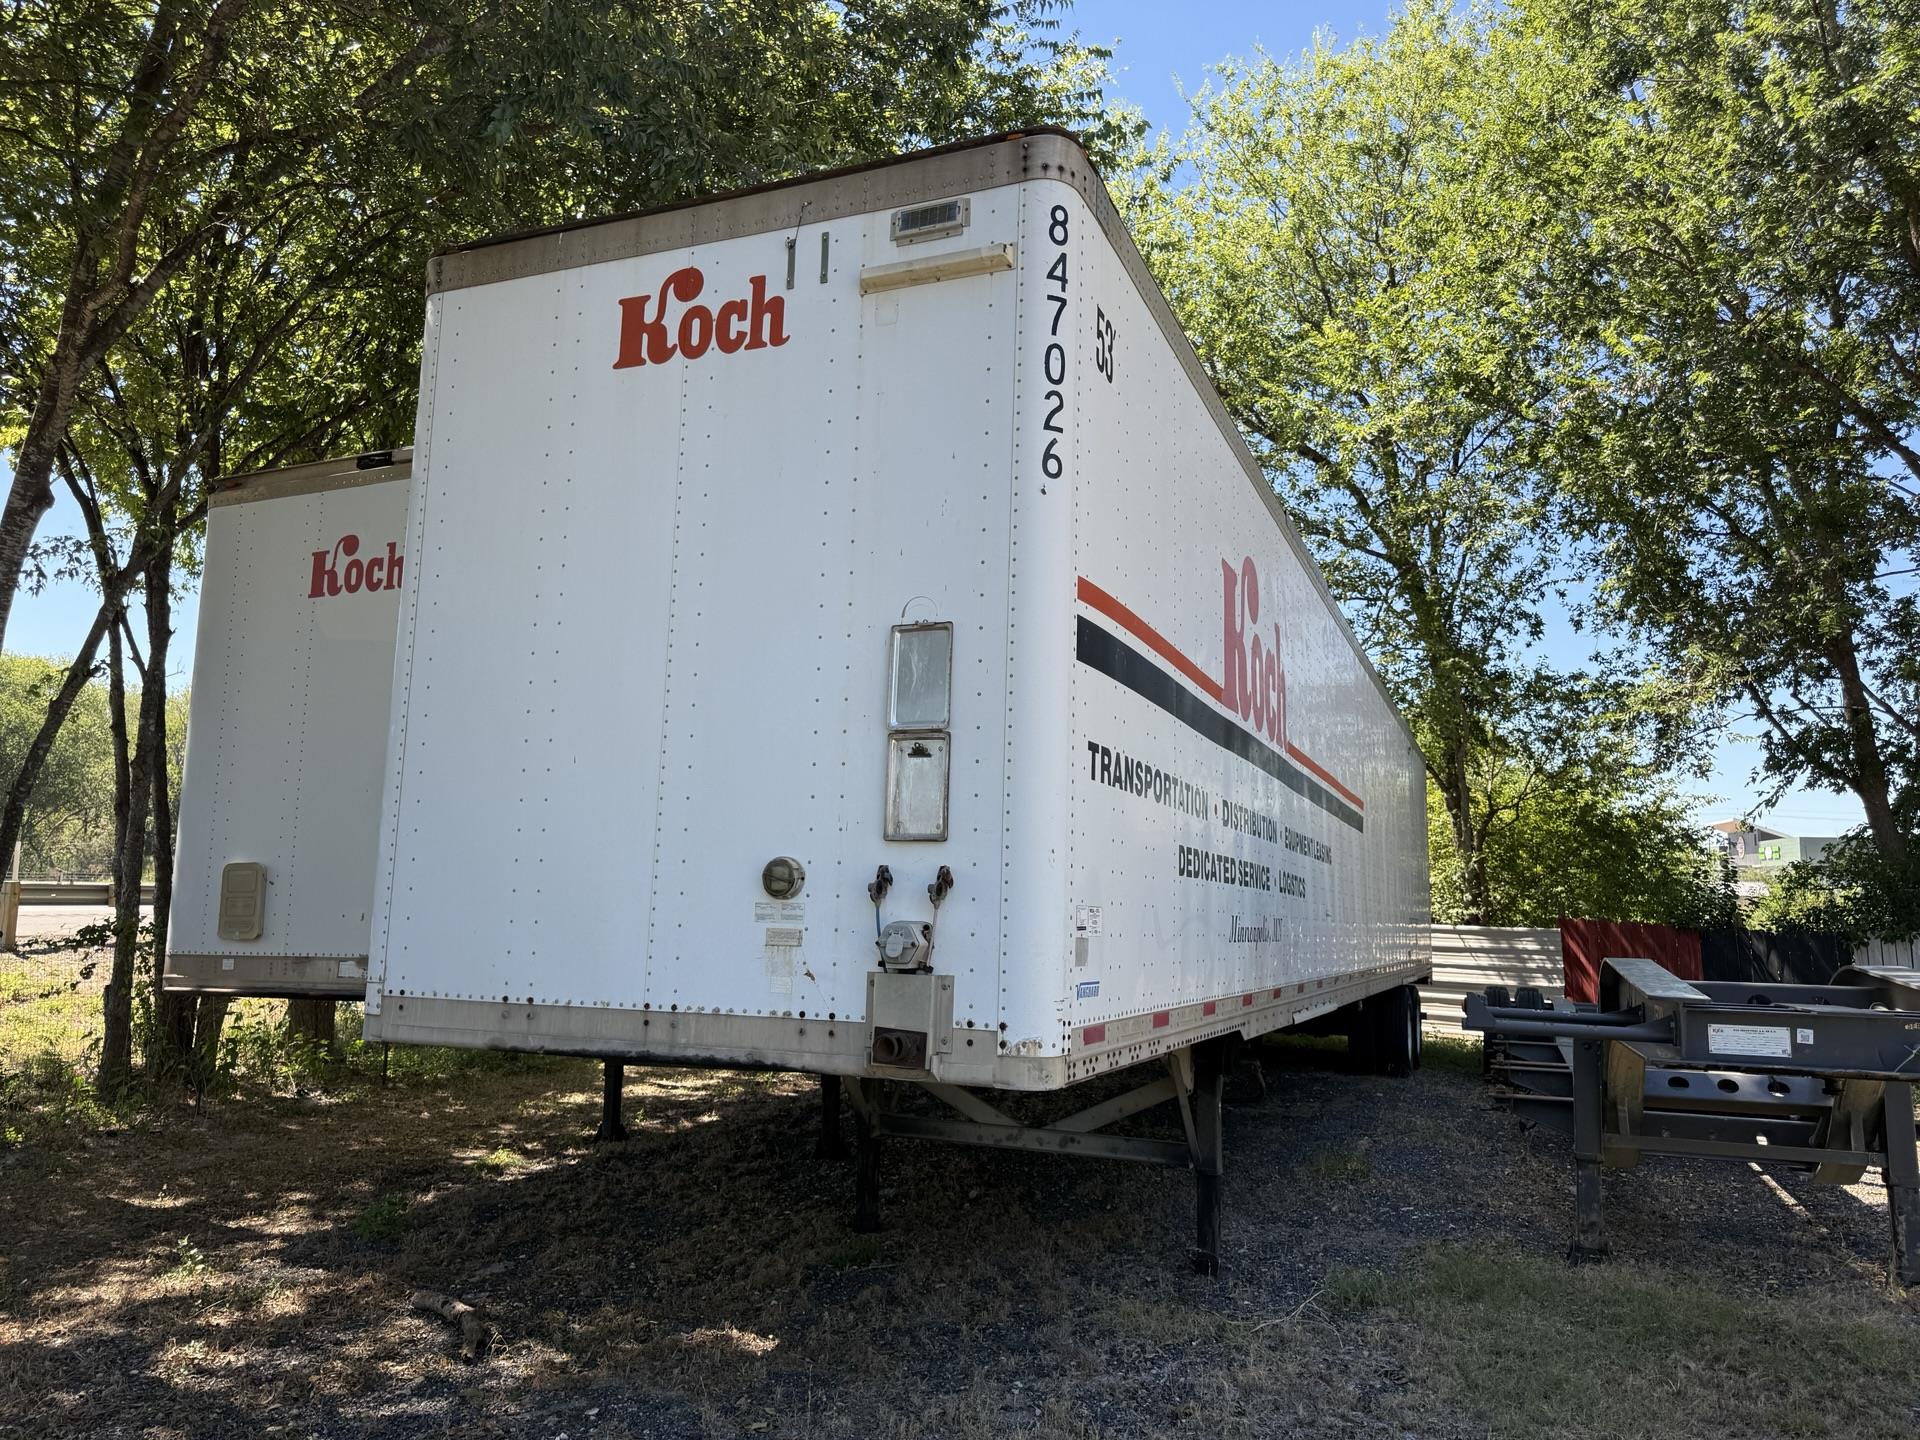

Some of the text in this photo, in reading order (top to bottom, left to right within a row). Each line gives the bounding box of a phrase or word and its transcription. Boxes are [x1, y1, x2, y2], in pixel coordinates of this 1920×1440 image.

[612, 267, 791, 370] Koch
[1041, 204, 1070, 479] 847026
[308, 534, 405, 599] Koch
[1221, 555, 1289, 754] Koch
[1087, 740, 1209, 822] TRANSPORTATION
[1222, 799, 1278, 845] DISTRIBUTION
[1178, 844, 1306, 899] DEDICATED SERVICE LOGISTICS
